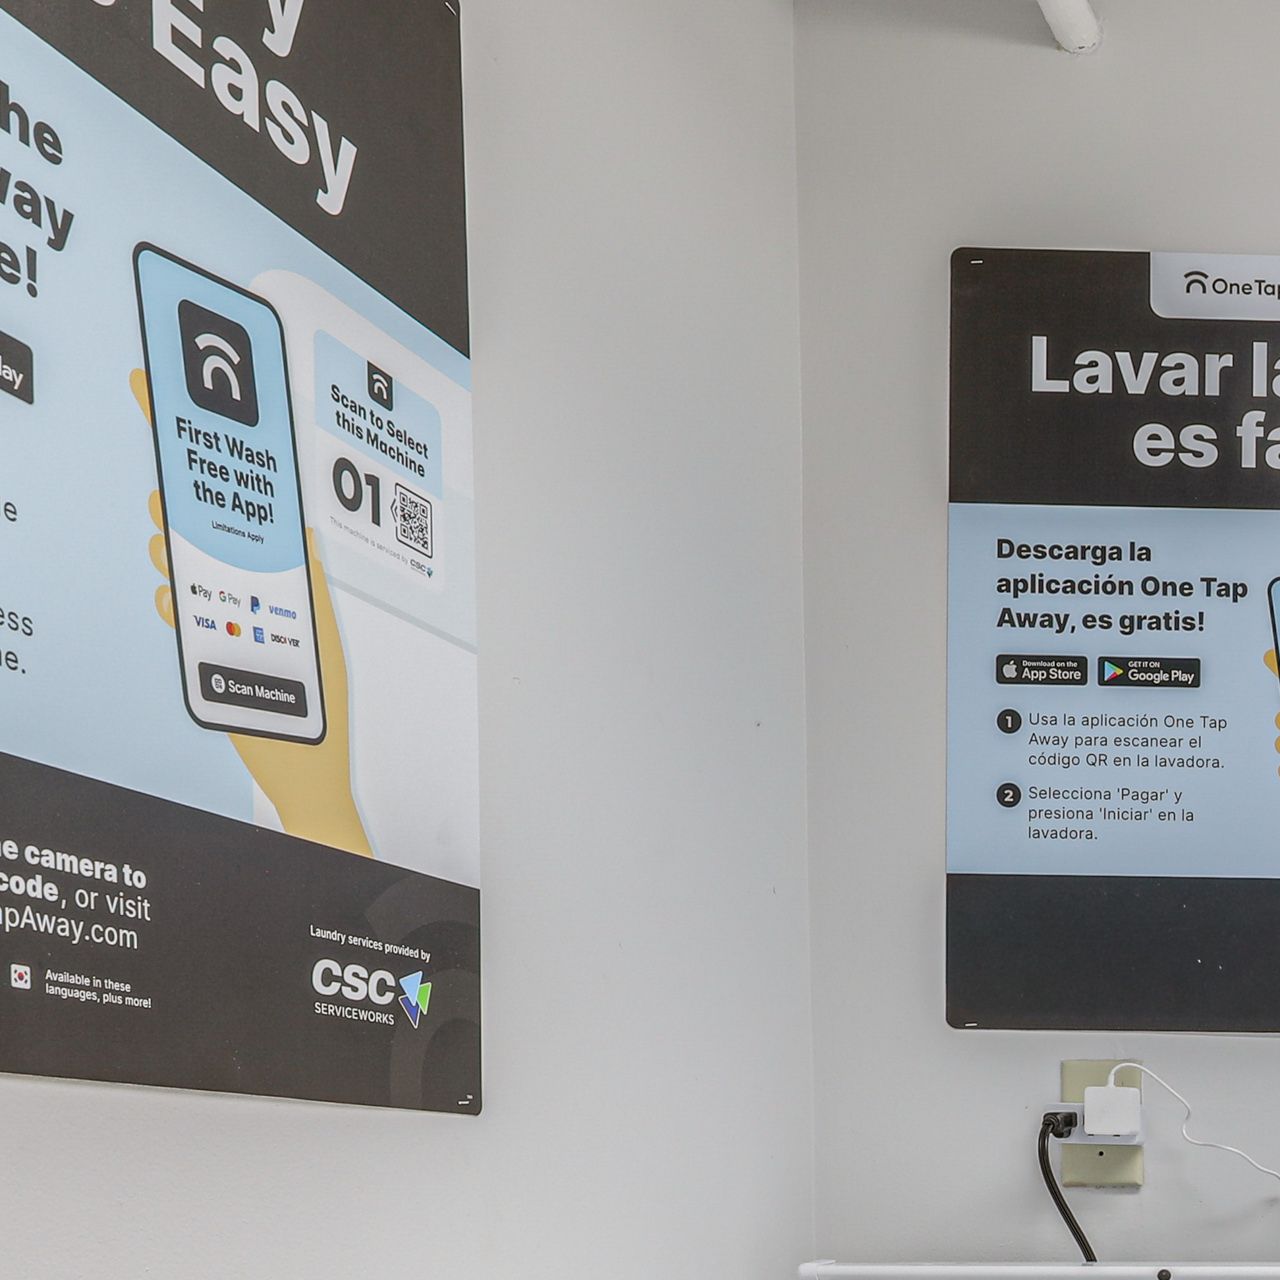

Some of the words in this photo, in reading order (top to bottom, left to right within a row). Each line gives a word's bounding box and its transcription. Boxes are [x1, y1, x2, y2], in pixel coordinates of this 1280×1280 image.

[152, 0, 358, 216] Easy
[1030, 334, 1233, 397] Lavar
[330, 383, 367, 421] Scan
[369, 409, 384, 429] to
[386, 420, 429, 460] Select
[175, 415, 222, 453] First
[224, 434, 278, 473] Wash
[335, 410, 364, 440] this
[366, 430, 426, 478] Machine
[1132, 420, 1219, 469] es
[186, 448, 231, 483] Free
[234, 469, 275, 498] with
[193, 479, 226, 510] the
[231, 491, 275, 526] App!
[996, 538, 1123, 566] Descarga
[1129, 541, 1152, 562] la
[996, 572, 1134, 599] aplicación
[1141, 576, 1194, 597] One
[1200, 577, 1248, 603] Tap
[193, 615, 217, 631] VISA
[268, 605, 297, 620] venmo
[996, 607, 1076, 634] Away,
[1082, 612, 1112, 630] es
[1119, 610, 1205, 635] gratis!
[1021, 668, 1048, 681] App
[1049, 668, 1082, 681] Store
[1127, 669, 1170, 685] Google
[1171, 669, 1195, 685] Play
[228, 679, 254, 697] Scan
[255, 684, 296, 704] Machine
[1028, 712, 1058, 726] Usa
[1063, 713, 1076, 727] la
[1081, 713, 1158, 730] aplicación
[1163, 714, 1194, 729] One
[1199, 714, 1228, 732] Tap
[1028, 732, 1069, 748] Away
[1074, 735, 1108, 749] para
[1113, 735, 1184, 749] escanear
[1188, 735, 1202, 749] el
[1028, 753, 1081, 769] código
[1085, 753, 1108, 768] QR
[1113, 755, 1132, 768] en
[1137, 754, 1150, 768] la
[1154, 755, 1225, 769] lavadora.
[1028, 786, 1112, 801] Selecciona
[1116, 787, 1169, 805] 'Pagar'
[1174, 789, 1183, 804] y
[1028, 807, 1094, 822] presiona
[1099, 808, 1153, 822] 'Iniciar'
[1157, 809, 1176, 822] en
[1181, 809, 1194, 822] la
[1028, 826, 1099, 841] lavadora.
[24, 844, 118, 884] camera
[122, 863, 147, 889] to
[75, 888, 99, 910] or
[105, 891, 152, 922] visit
[310, 924, 346, 945] Laundry
[348, 935, 383, 951] services
[384, 943, 419, 959] provided
[420, 949, 431, 963] by
[45, 969, 91, 987] Available
[92, 976, 102, 988] in
[103, 978, 131, 993] these
[312, 958, 397, 1006] CSC
[45, 982, 100, 1004] languages,
[102, 992, 123, 1005] plus
[125, 994, 152, 1009] more!
[314, 1001, 395, 1026] SERVICEWORKS
